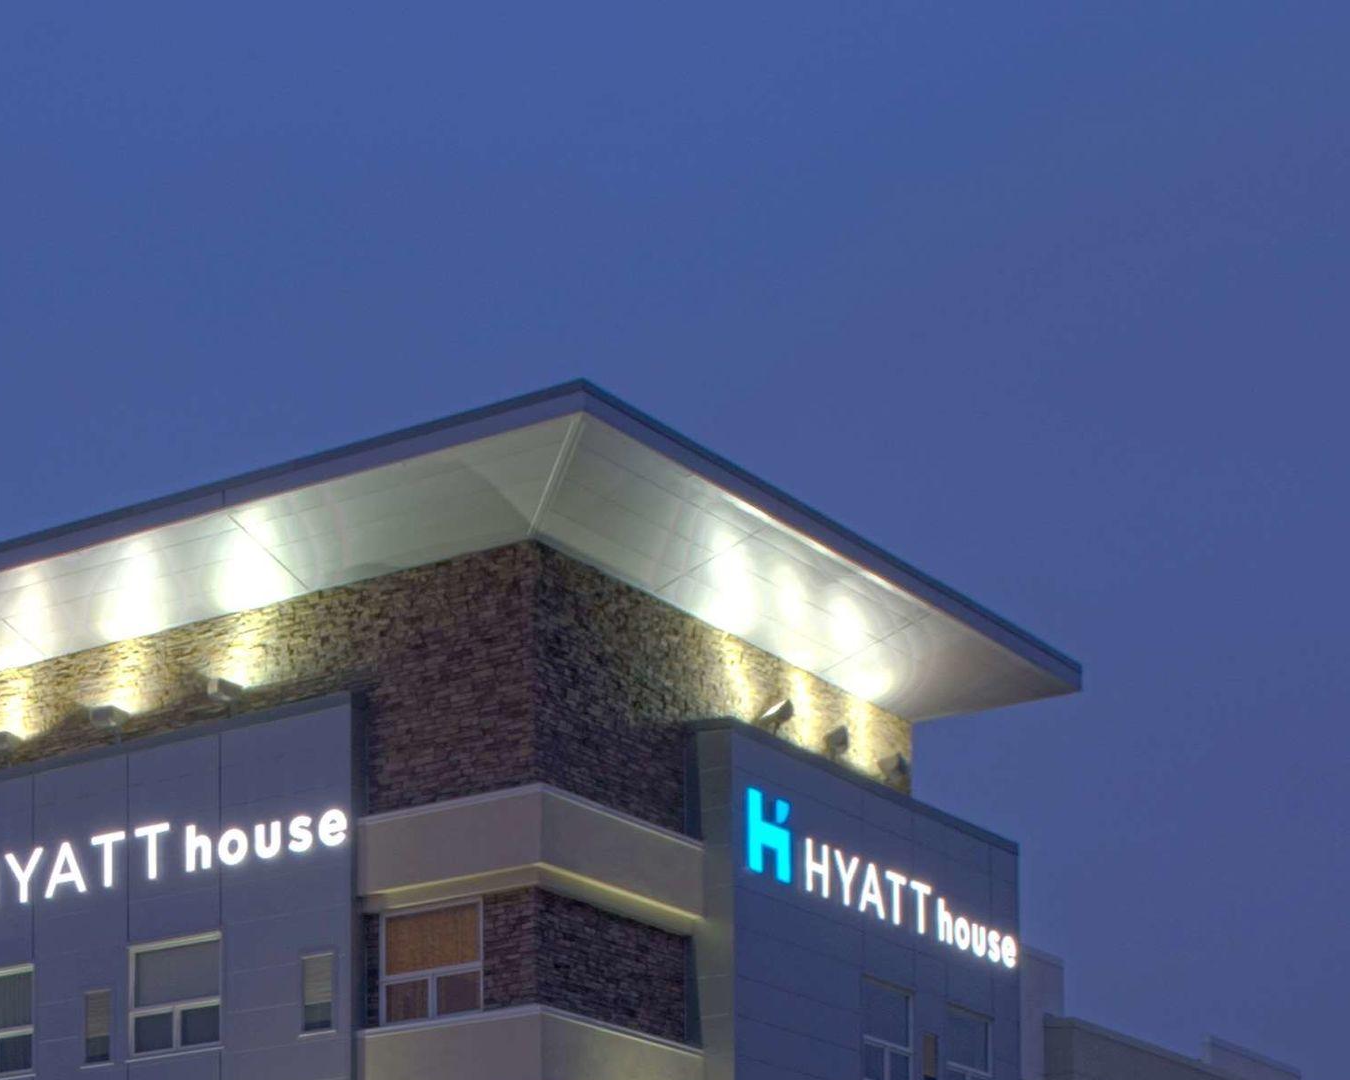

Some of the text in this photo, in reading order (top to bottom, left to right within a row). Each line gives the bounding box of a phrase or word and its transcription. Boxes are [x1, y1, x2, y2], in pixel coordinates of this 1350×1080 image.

[184, 808, 348, 873] house
[804, 837, 933, 935] HYATT
[936, 896, 1018, 969] house
